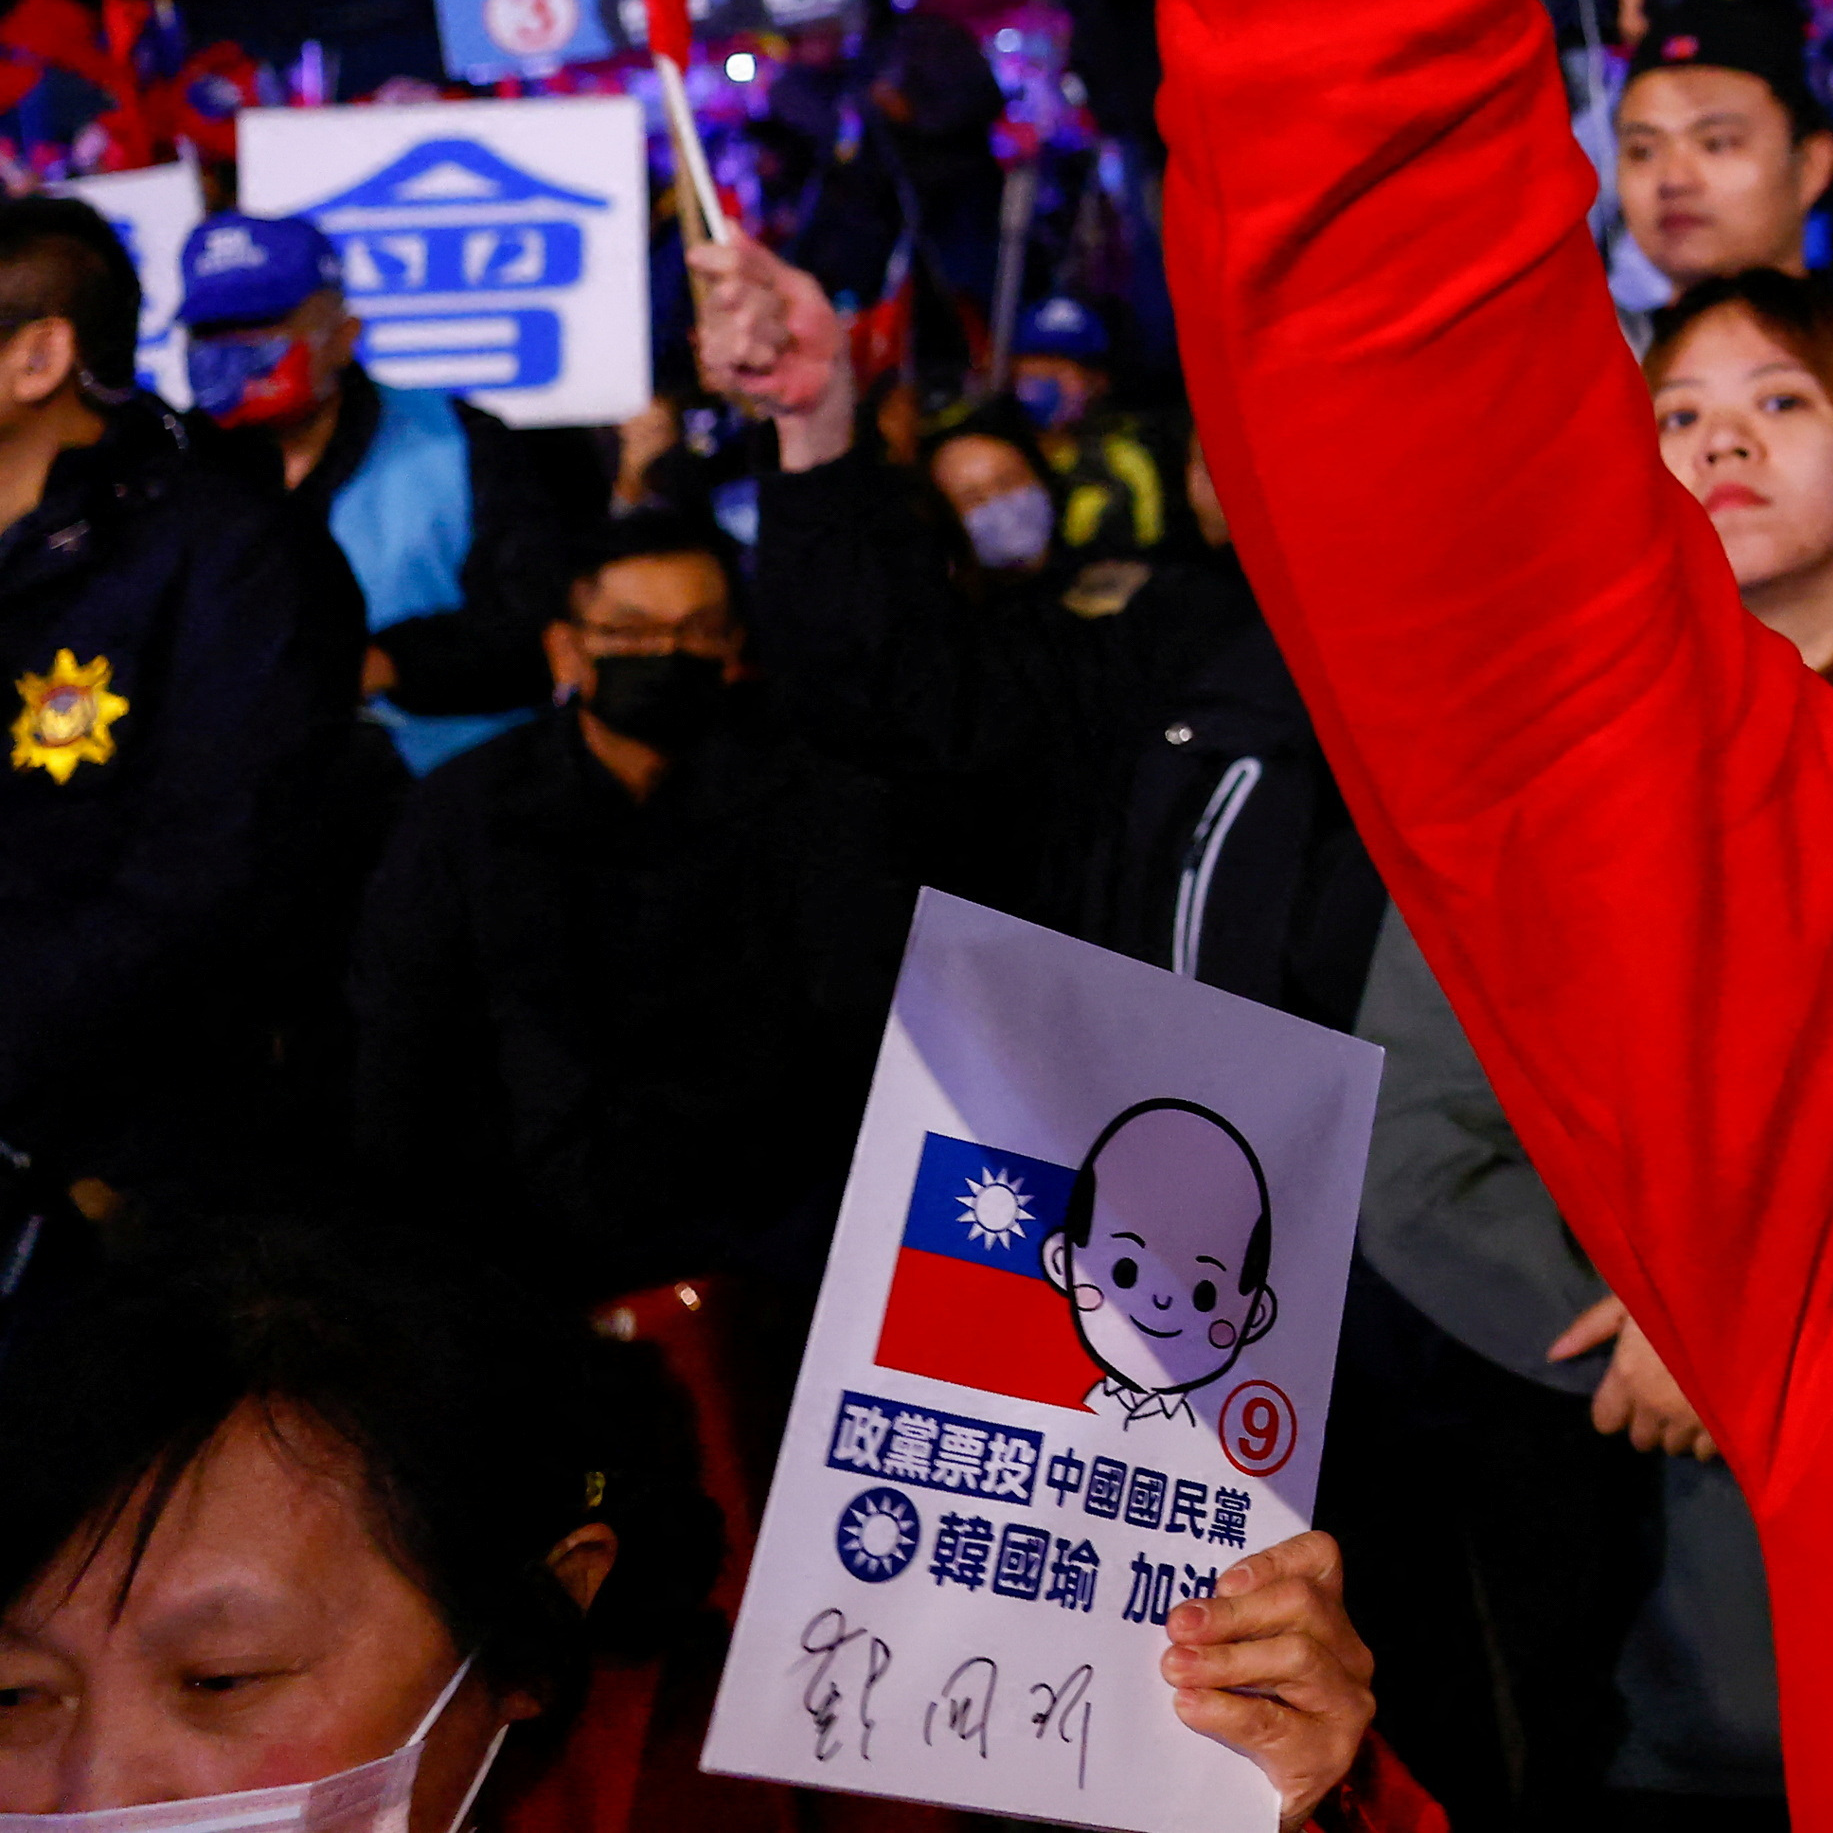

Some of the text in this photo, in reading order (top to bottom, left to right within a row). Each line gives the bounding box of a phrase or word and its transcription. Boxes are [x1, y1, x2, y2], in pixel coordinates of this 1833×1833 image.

[831, 1402, 1252, 1550] 政黨票投 中國國民黨
[1238, 1396, 1280, 1461] 9
[927, 1510, 1102, 1613] 韓國瑜
